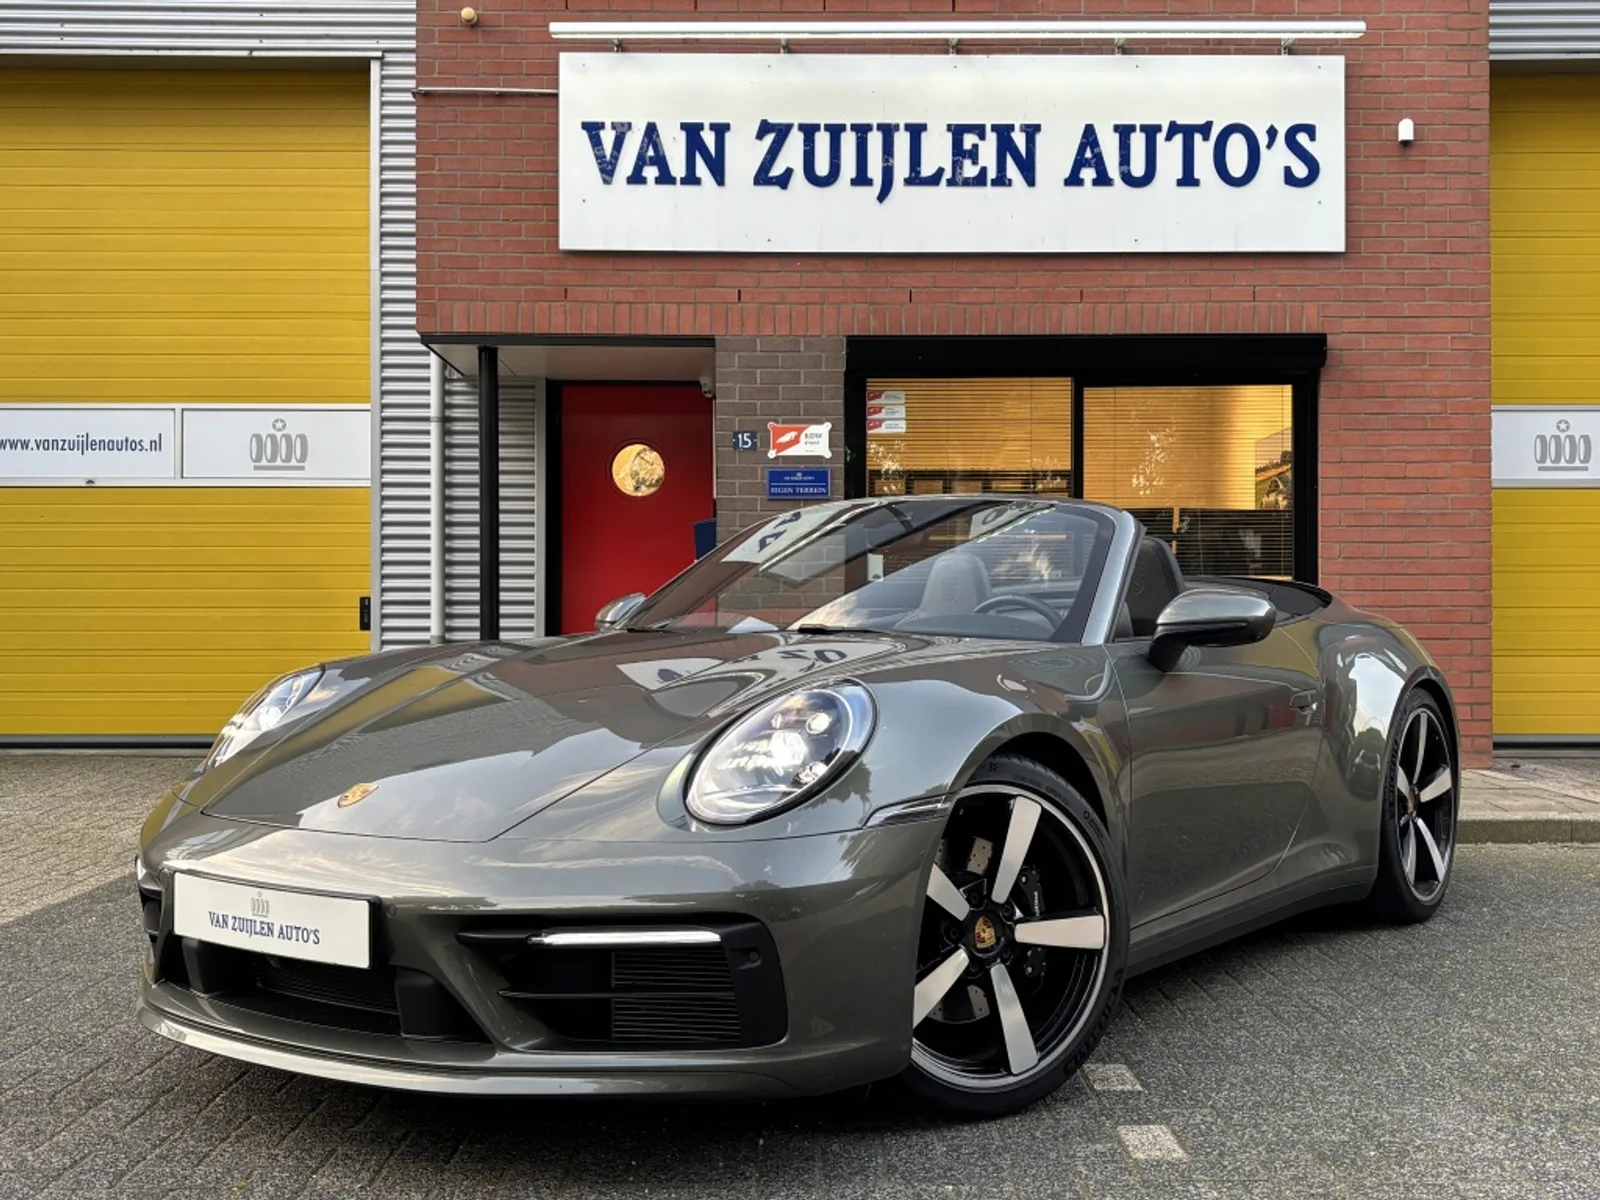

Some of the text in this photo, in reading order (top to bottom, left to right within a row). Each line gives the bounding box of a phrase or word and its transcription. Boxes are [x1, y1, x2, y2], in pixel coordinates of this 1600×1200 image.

[581, 119, 1321, 204] VAN ZUIJLEN AUTO'S
[0, 432, 162, 456] www.vanzuijlenautos.nl
[738, 432, 752, 448] 15
[208, 911, 320, 945] VAN ZUIJLEN AUTO'S
